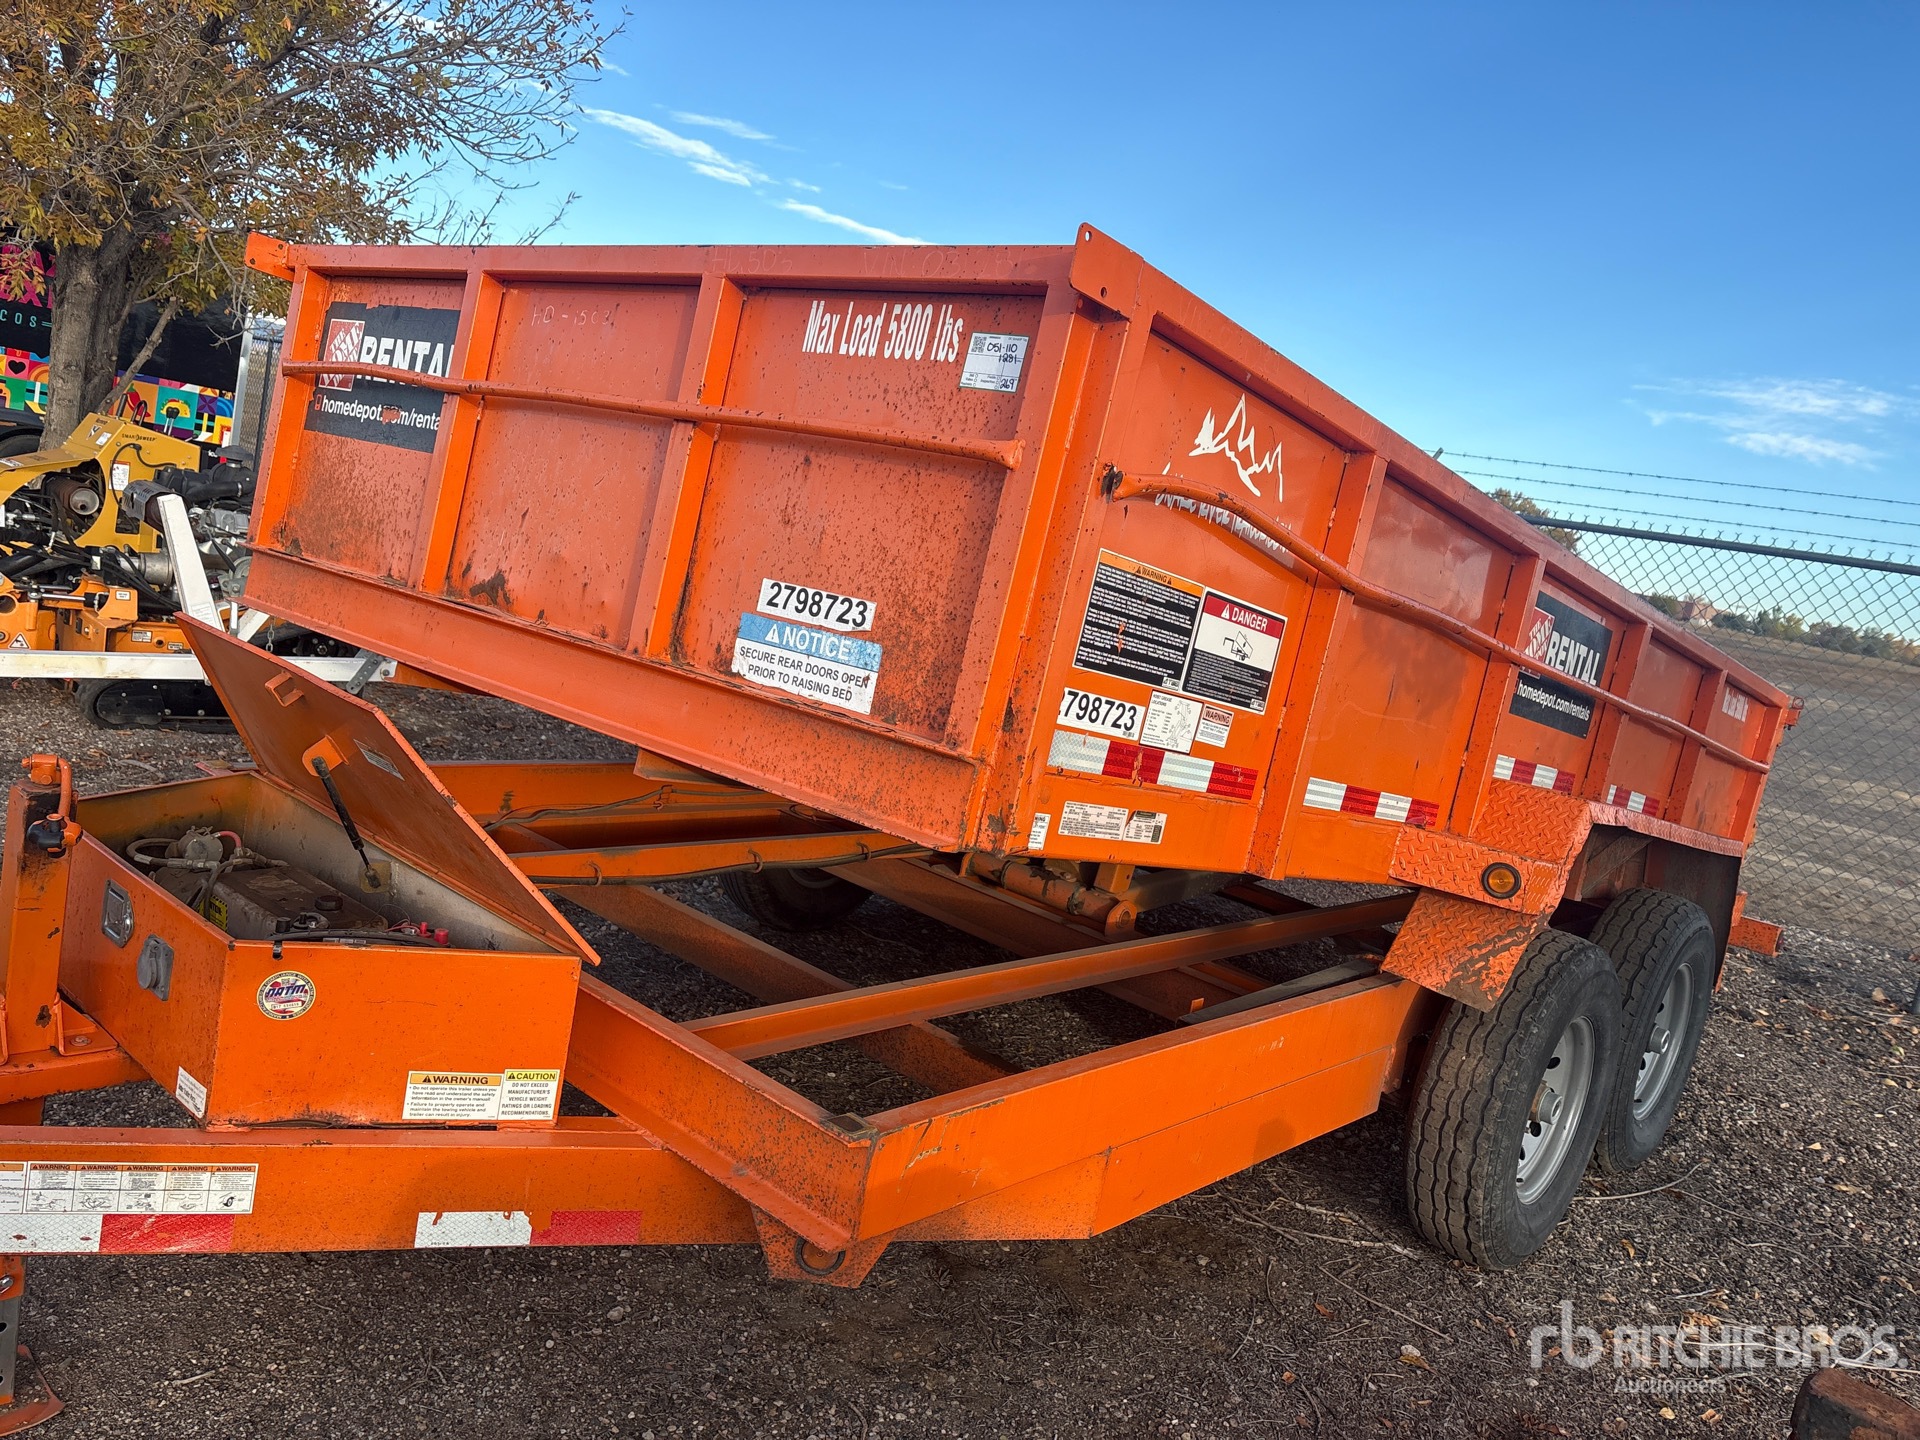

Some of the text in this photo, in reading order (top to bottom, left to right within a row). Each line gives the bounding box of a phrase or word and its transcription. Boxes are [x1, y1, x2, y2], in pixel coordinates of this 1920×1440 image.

[802, 300, 964, 363] Max Load 5800 lbs
[321, 398, 441, 430] homedepot.m/renta
[1141, 566, 1168, 584] WARNING
[766, 582, 868, 627] 2798723
[1231, 607, 1268, 632] DANGER
[783, 626, 852, 660] NOTICE
[1545, 631, 1600, 686] RENTAL
[739, 646, 869, 689] SECURE REAR DOORS OPEN
[748, 664, 853, 702] PRIOR TO RAISING BED
[1059, 690, 1137, 732] 798723
[1205, 710, 1230, 724] WARNING
[1517, 680, 1591, 721] homedepot.com/rentals
[433, 1075, 489, 1085] WARNING
